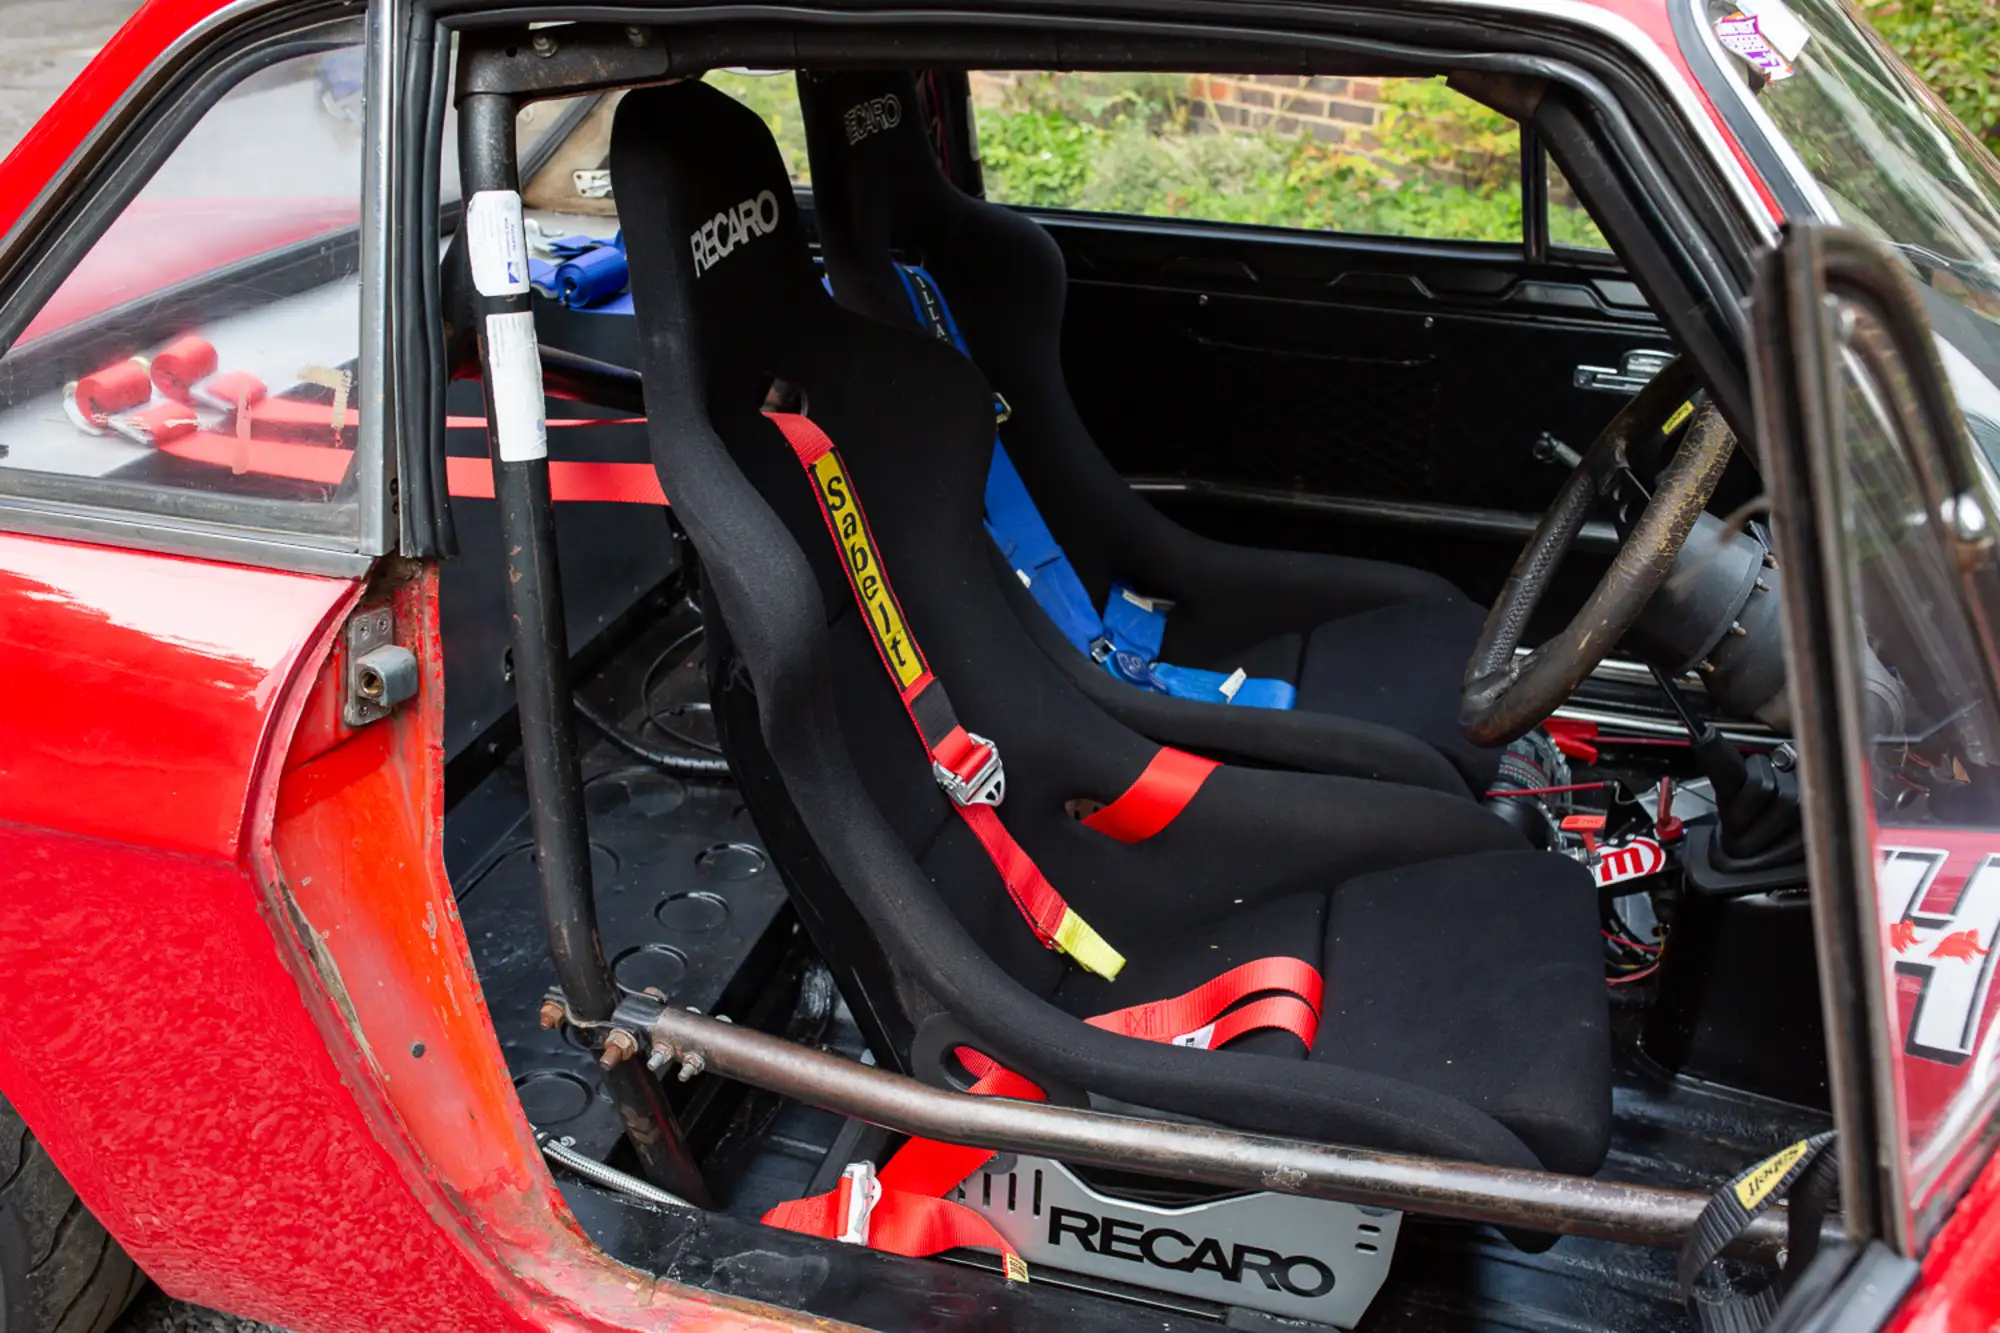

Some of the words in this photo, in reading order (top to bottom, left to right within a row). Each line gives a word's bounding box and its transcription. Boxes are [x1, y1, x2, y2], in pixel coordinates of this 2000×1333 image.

[690, 189, 779, 278] RECARO
[902, 265, 949, 342] ILLA
[827, 475, 907, 668] Sabelt
[1048, 1205, 1336, 1298] RECARO
